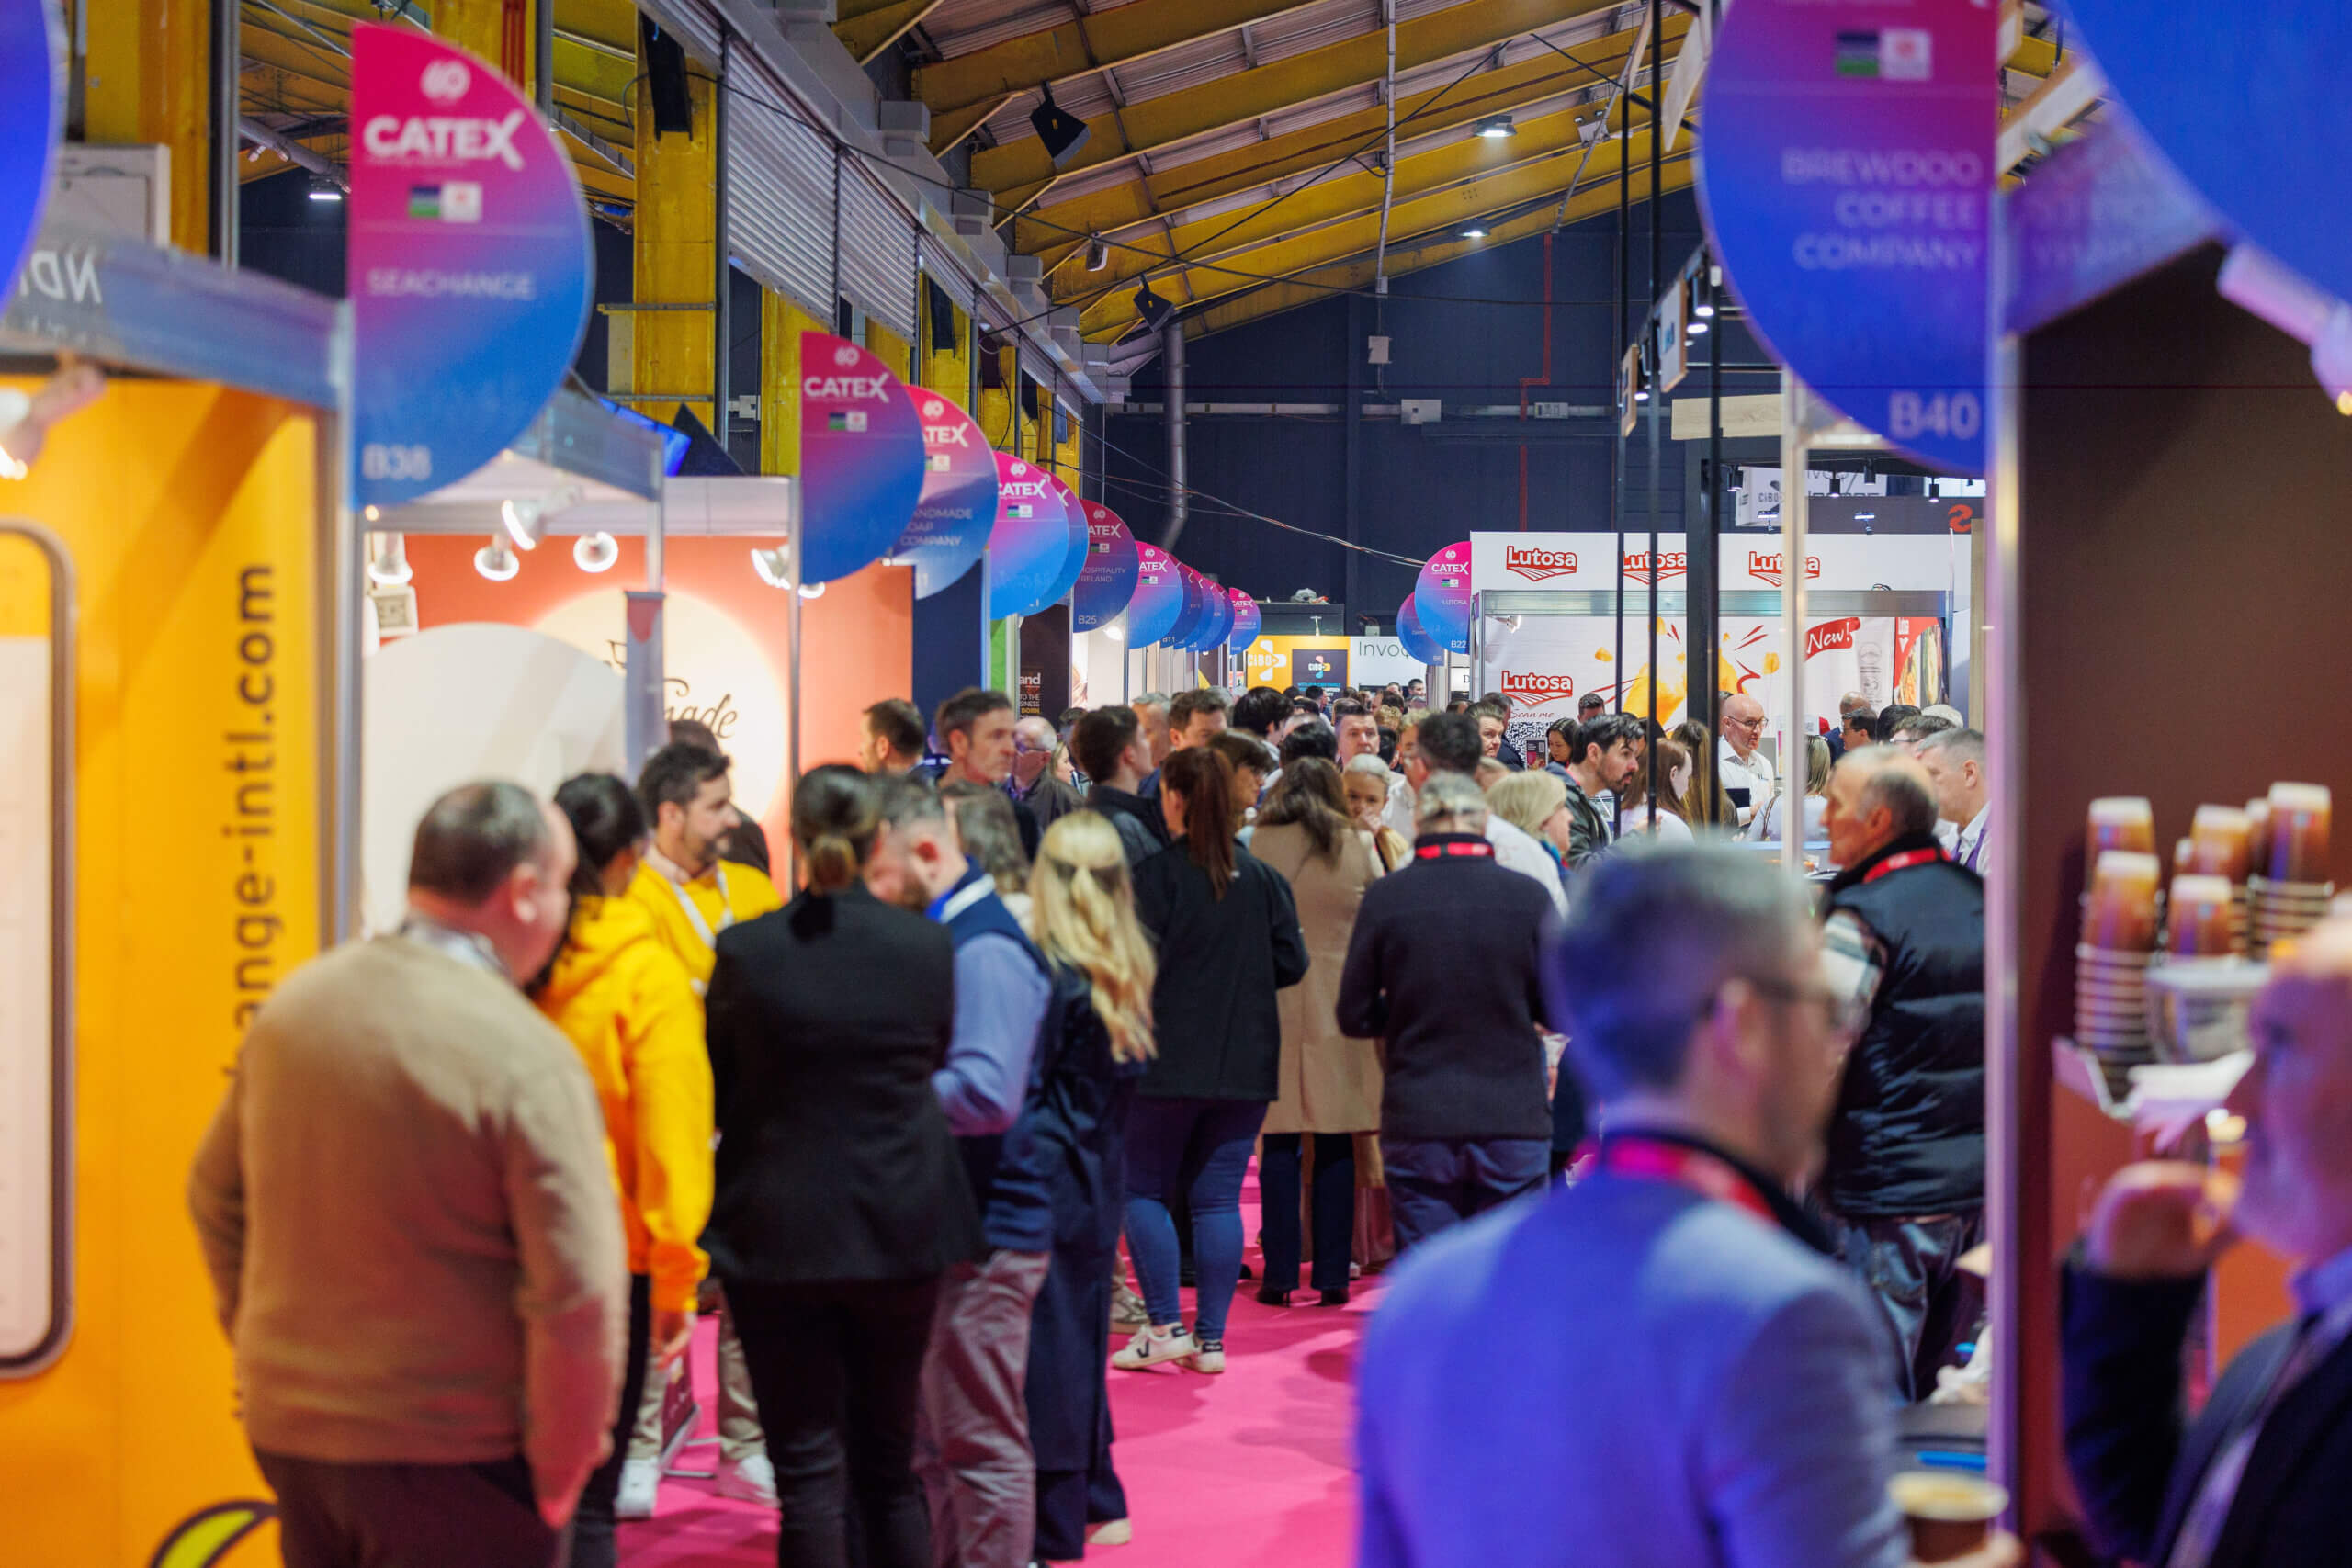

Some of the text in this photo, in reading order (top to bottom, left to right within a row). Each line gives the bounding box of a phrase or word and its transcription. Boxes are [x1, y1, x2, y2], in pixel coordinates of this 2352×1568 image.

[364, 110, 524, 171] CATEX
[1836, 192, 1977, 229] COFFEE
[1793, 234, 1981, 270] COMPANY
[368, 269, 535, 300] SEACHANGE
[804, 372, 889, 403] CATEX
[1889, 393, 1982, 440] B40
[922, 422, 969, 447] TEX
[915, 508, 973, 520] NDMADE
[1088, 523, 1122, 538] ATEX
[1138, 559, 1168, 573] ATEX
[1507, 547, 1577, 567] Lutosa
[1749, 551, 1820, 571] Luta
[1431, 561, 1469, 575] CATEX
[1078, 615, 1097, 625] B25
[1451, 639, 1467, 649] B22
[1806, 621, 1850, 655] New!
[1502, 671, 1573, 691] Lutosa
